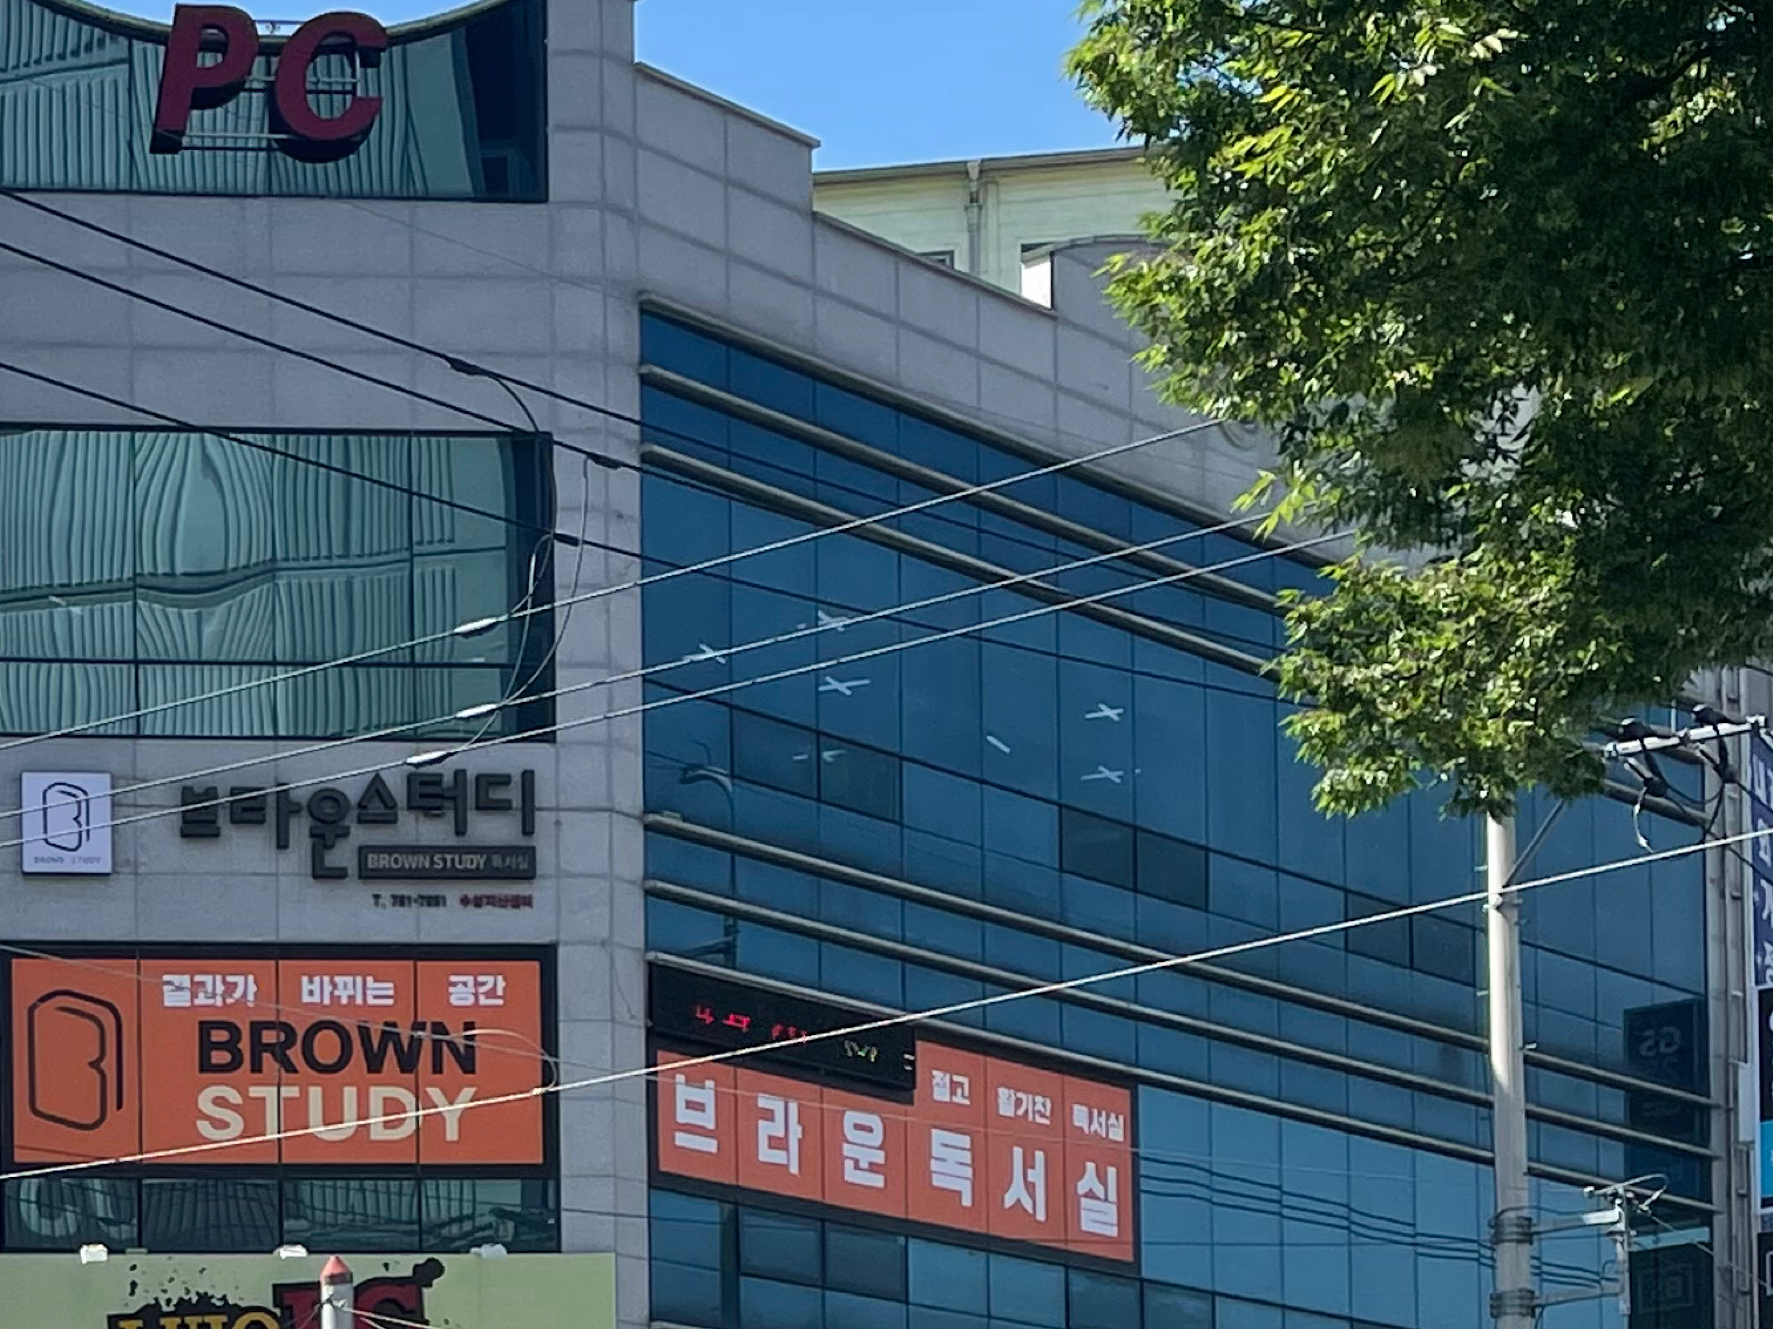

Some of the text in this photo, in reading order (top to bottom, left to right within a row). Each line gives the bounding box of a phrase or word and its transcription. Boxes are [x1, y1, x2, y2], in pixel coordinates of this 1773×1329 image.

[149, 3, 388, 163] PC
[181, 768, 534, 879] 브라운스터디
[367, 853, 429, 869] BROWN
[433, 853, 487, 869] STUDY
[161, 973, 506, 1008] 결과가 바뀌는 공간
[197, 1019, 477, 1075] BROWN
[195, 1084, 478, 1143] STUDY
